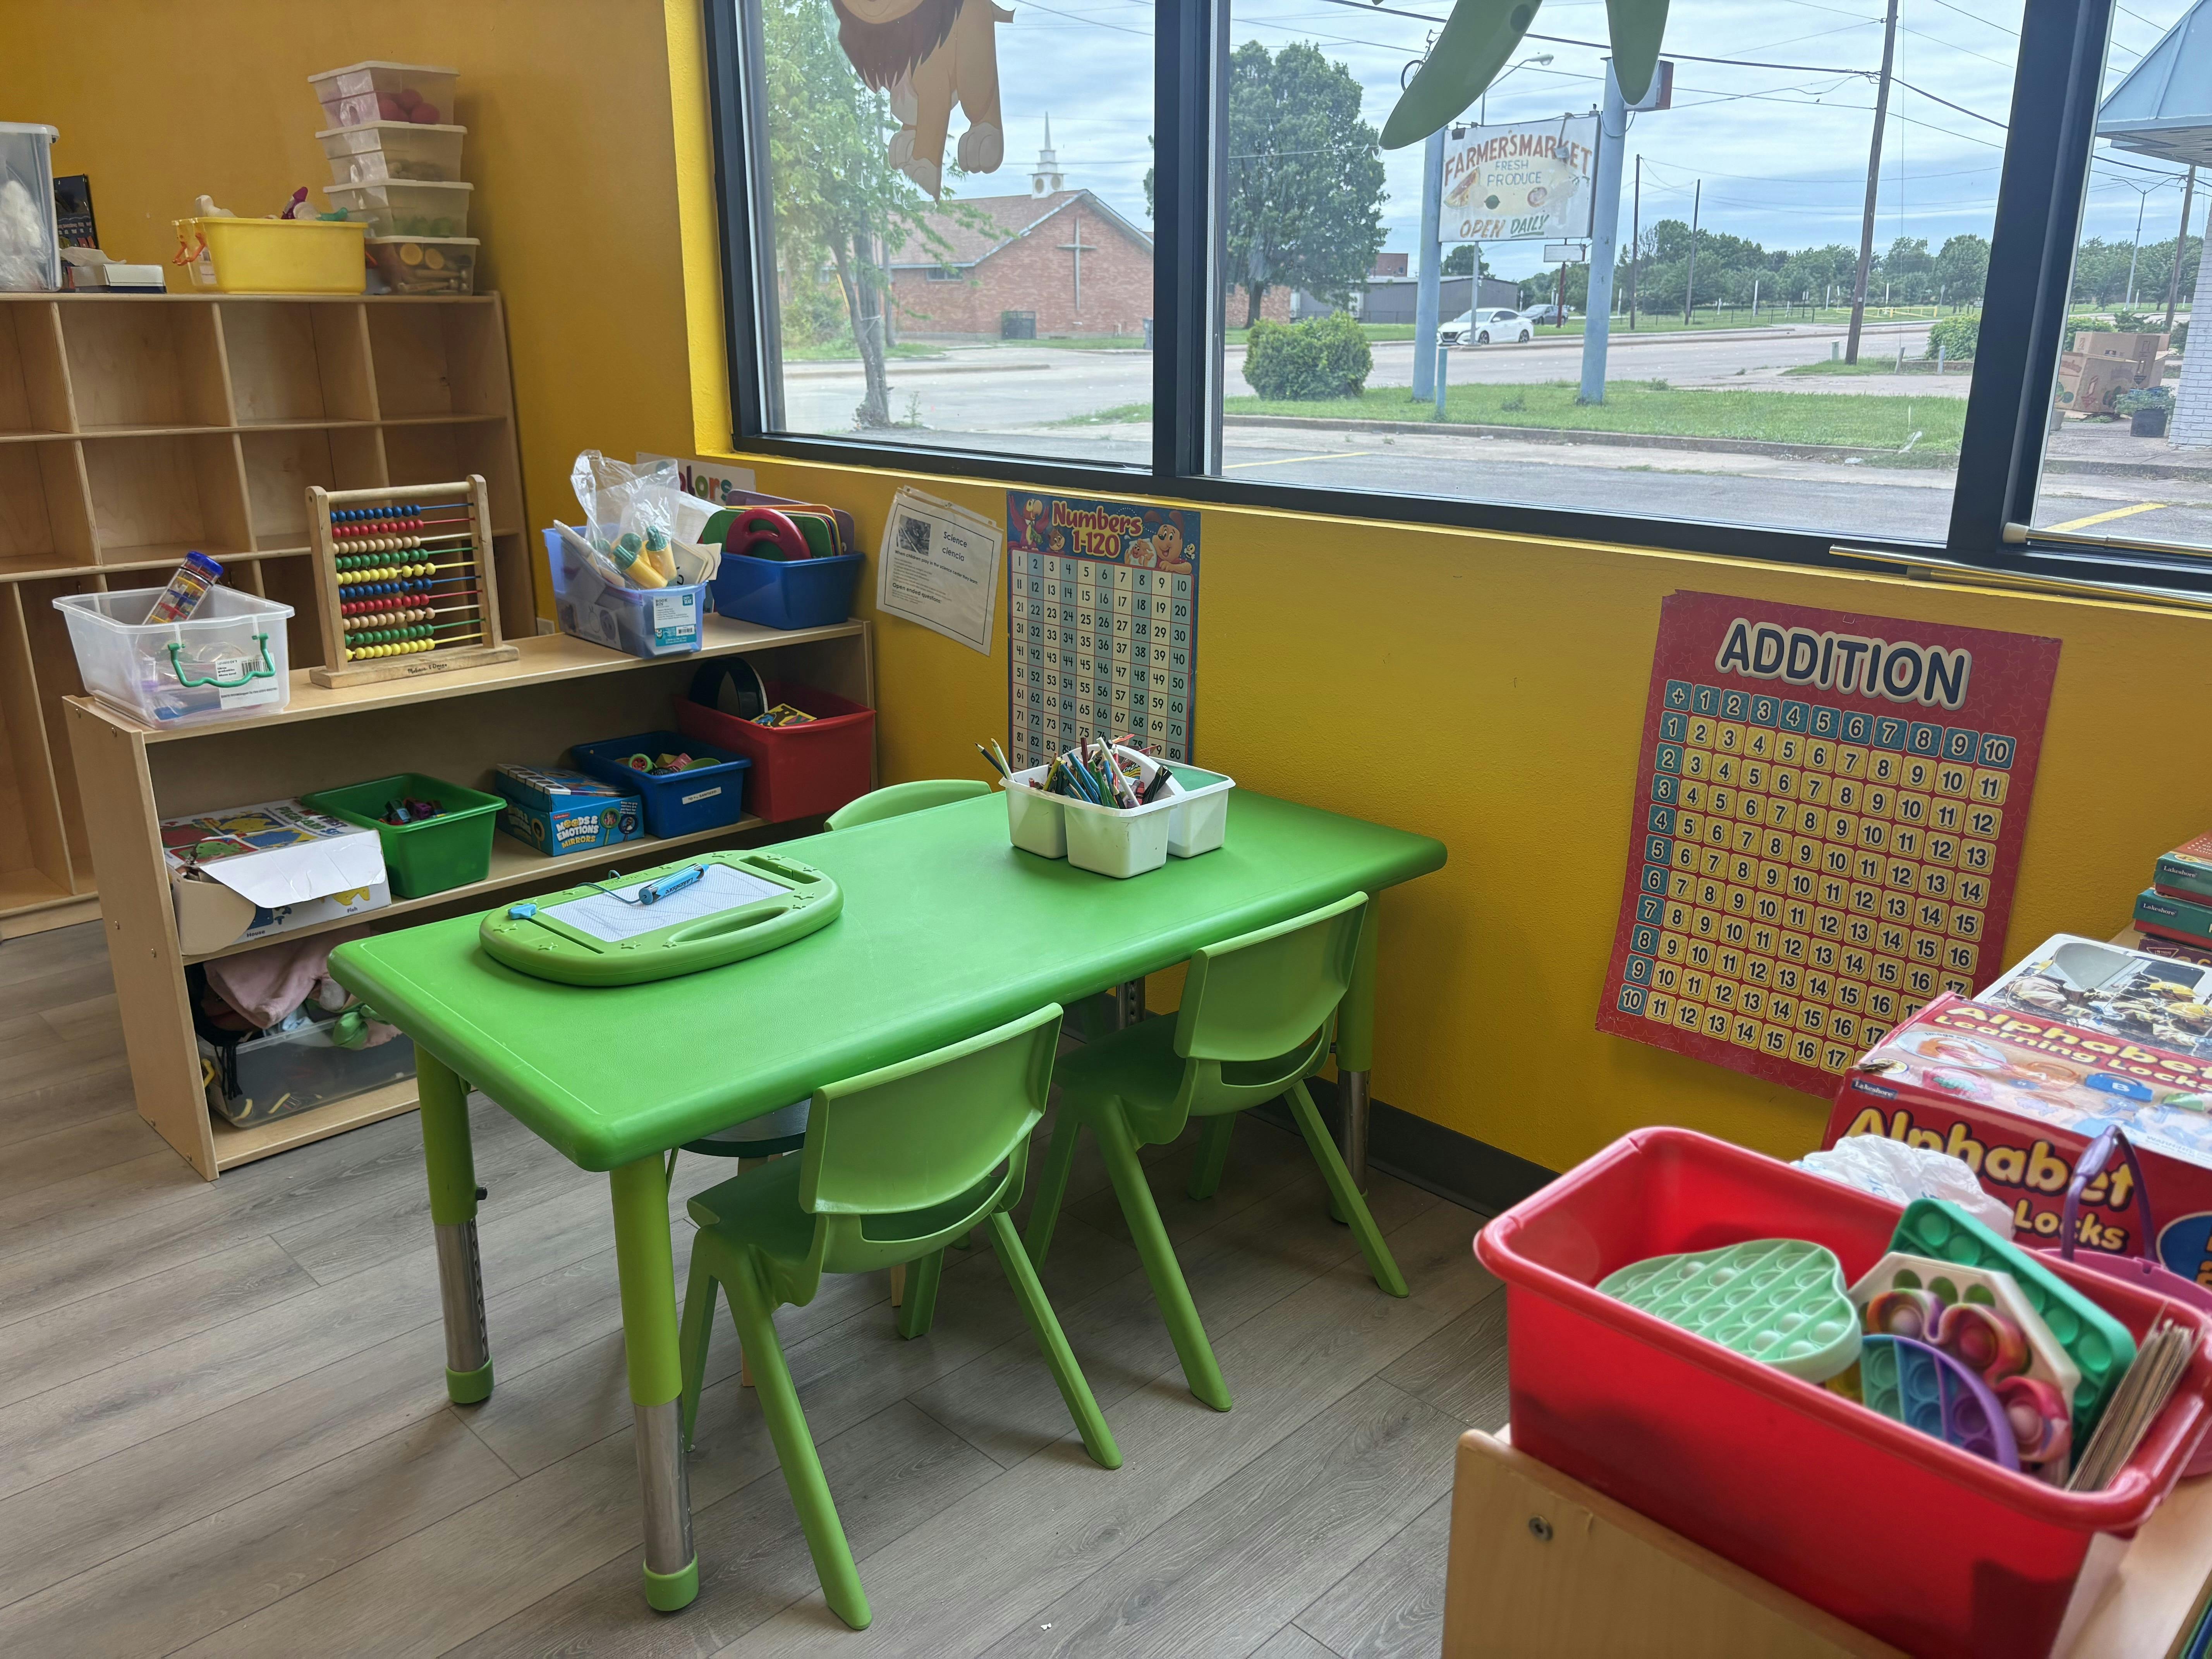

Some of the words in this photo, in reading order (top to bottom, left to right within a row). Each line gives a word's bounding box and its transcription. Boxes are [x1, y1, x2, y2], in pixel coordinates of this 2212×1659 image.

[1487, 172, 1542, 186] PRODUCE
[1495, 160, 1529, 172] FRESH
[1460, 219, 1506, 238] OPEN
[1510, 214, 1550, 234] DAILY
[1053, 501, 1143, 536] Numbers
[943, 531, 967, 548] Science
[1072, 529, 1120, 558] 1-120
[942, 547, 965, 562] ciencia
[1033, 558, 1038, 569] 2
[1049, 561, 1054, 572] 3
[1066, 563, 1071, 575] 4
[1084, 566, 1089, 577] 5
[1102, 569, 1108, 580] 6
[1120, 572, 1126, 583] 7
[1139, 574, 1146, 586] 8
[1159, 577, 1165, 589] 9
[1177, 580, 1187, 592] 10
[892, 582, 906, 591] Open
[906, 587, 921, 596] ended
[921, 592, 942, 604] questions:
[1017, 579, 1022, 589] 11
[1032, 581, 1039, 593] 12
[1048, 584, 1056, 596] 13
[1064, 587, 1073, 599] 14
[1082, 590, 1091, 601] 15
[1100, 592, 1109, 605] 16
[1118, 596, 1127, 607] 17
[1137, 599, 1146, 611] 18
[1156, 601, 1166, 614] 19
[1175, 604, 1187, 617] 20
[1016, 601, 1024, 612] 21
[1030, 604, 1040, 616] 22
[1046, 607, 1057, 619] 23
[1063, 610, 1074, 622] 24
[1080, 613, 1091, 625] 25
[1098, 616, 1109, 629] 26
[1116, 619, 1128, 632] 27
[1135, 623, 1147, 635] 28
[1154, 626, 1167, 638] 29
[1173, 629, 1186, 642] 30
[1016, 623, 1024, 634] 31
[1030, 625, 1040, 637] 32
[1046, 629, 1057, 641] 33
[1063, 632, 1073, 644] 34
[1080, 635, 1091, 647] 35
[1098, 639, 1109, 651] 36
[1116, 642, 1128, 654] 37
[1135, 646, 1146, 658] 38
[1154, 649, 1166, 661] 39
[1173, 653, 1185, 665] 40
[1717, 620, 1970, 708] ADDITION
[1701, 691, 1710, 710] 1
[1728, 696, 1740, 715] 2
[1759, 701, 1771, 720] 3
[1787, 707, 1799, 726] 4
[1817, 713, 1830, 732] 5
[1850, 718, 1863, 737] 6
[1884, 723, 1897, 743] 7
[1917, 729, 1931, 749] 8
[1953, 735, 1967, 755] 9
[1986, 740, 2008, 762] 10
[1669, 718, 1677, 737] 1
[1694, 723, 1707, 742] 2
[1723, 729, 1735, 747] 3
[1752, 735, 1764, 754] 4
[1782, 740, 1795, 759] 5
[1813, 746, 1825, 765] 6
[1845, 752, 1858, 771] 7
[1877, 758, 1890, 778] 8
[1911, 764, 1924, 784] 9
[1942, 770, 1963, 791] 10
[1980, 777, 1999, 798] 11
[1662, 750, 1674, 768] 2
[1690, 756, 1701, 774] 3
[1718, 761, 1730, 780] 4
[1748, 767, 1760, 785] 5
[1778, 773, 1790, 792] 6
[1809, 779, 1821, 798] 7
[1839, 786, 1852, 805] 8
[1872, 792, 1884, 811] 9
[1901, 798, 1922, 819] 10
[1938, 805, 1955, 826] 11
[1972, 812, 1994, 833] 12
[556, 824, 599, 842] EMOTIONS
[1659, 780, 1670, 798] 3
[1686, 787, 1698, 804] 4
[1715, 792, 1726, 810] 5
[1745, 799, 1757, 816] 6
[1775, 804, 1786, 823] 7
[1804, 811, 1816, 830] 8
[1835, 818, 1848, 837] 9
[1863, 824, 1883, 845] 10
[1898, 831, 1915, 852] 11
[1931, 838, 1952, 860] 12
[1966, 846, 1987, 867] 13
[561, 835, 596, 849] MIRRORS
[665, 877, 694, 895] Lakeshore
[2163, 865, 2198, 878] Lakeshore
[2143, 903, 2177, 916] Lakeshore
[246, 929, 266, 938] House
[1624, 989, 1641, 1009] 10
[1653, 998, 1668, 1017] 11
[1680, 1005, 1697, 1025] 12
[1708, 1013, 1726, 1033] 13
[1736, 1022, 1754, 1042] 14
[1766, 1030, 1784, 1050] 15
[1796, 1039, 1815, 1060] 16
[1827, 1048, 1847, 1068] 17
[1945, 1006, 2212, 1079] Alphabet
[1934, 1015, 2097, 1065] Learning
[2108, 1059, 2212, 1093] Locks
[1854, 1081, 1894, 1099] Lakeshore
[2111, 1082, 2131, 1092] B
[2014, 1199, 2127, 1251] Loks
